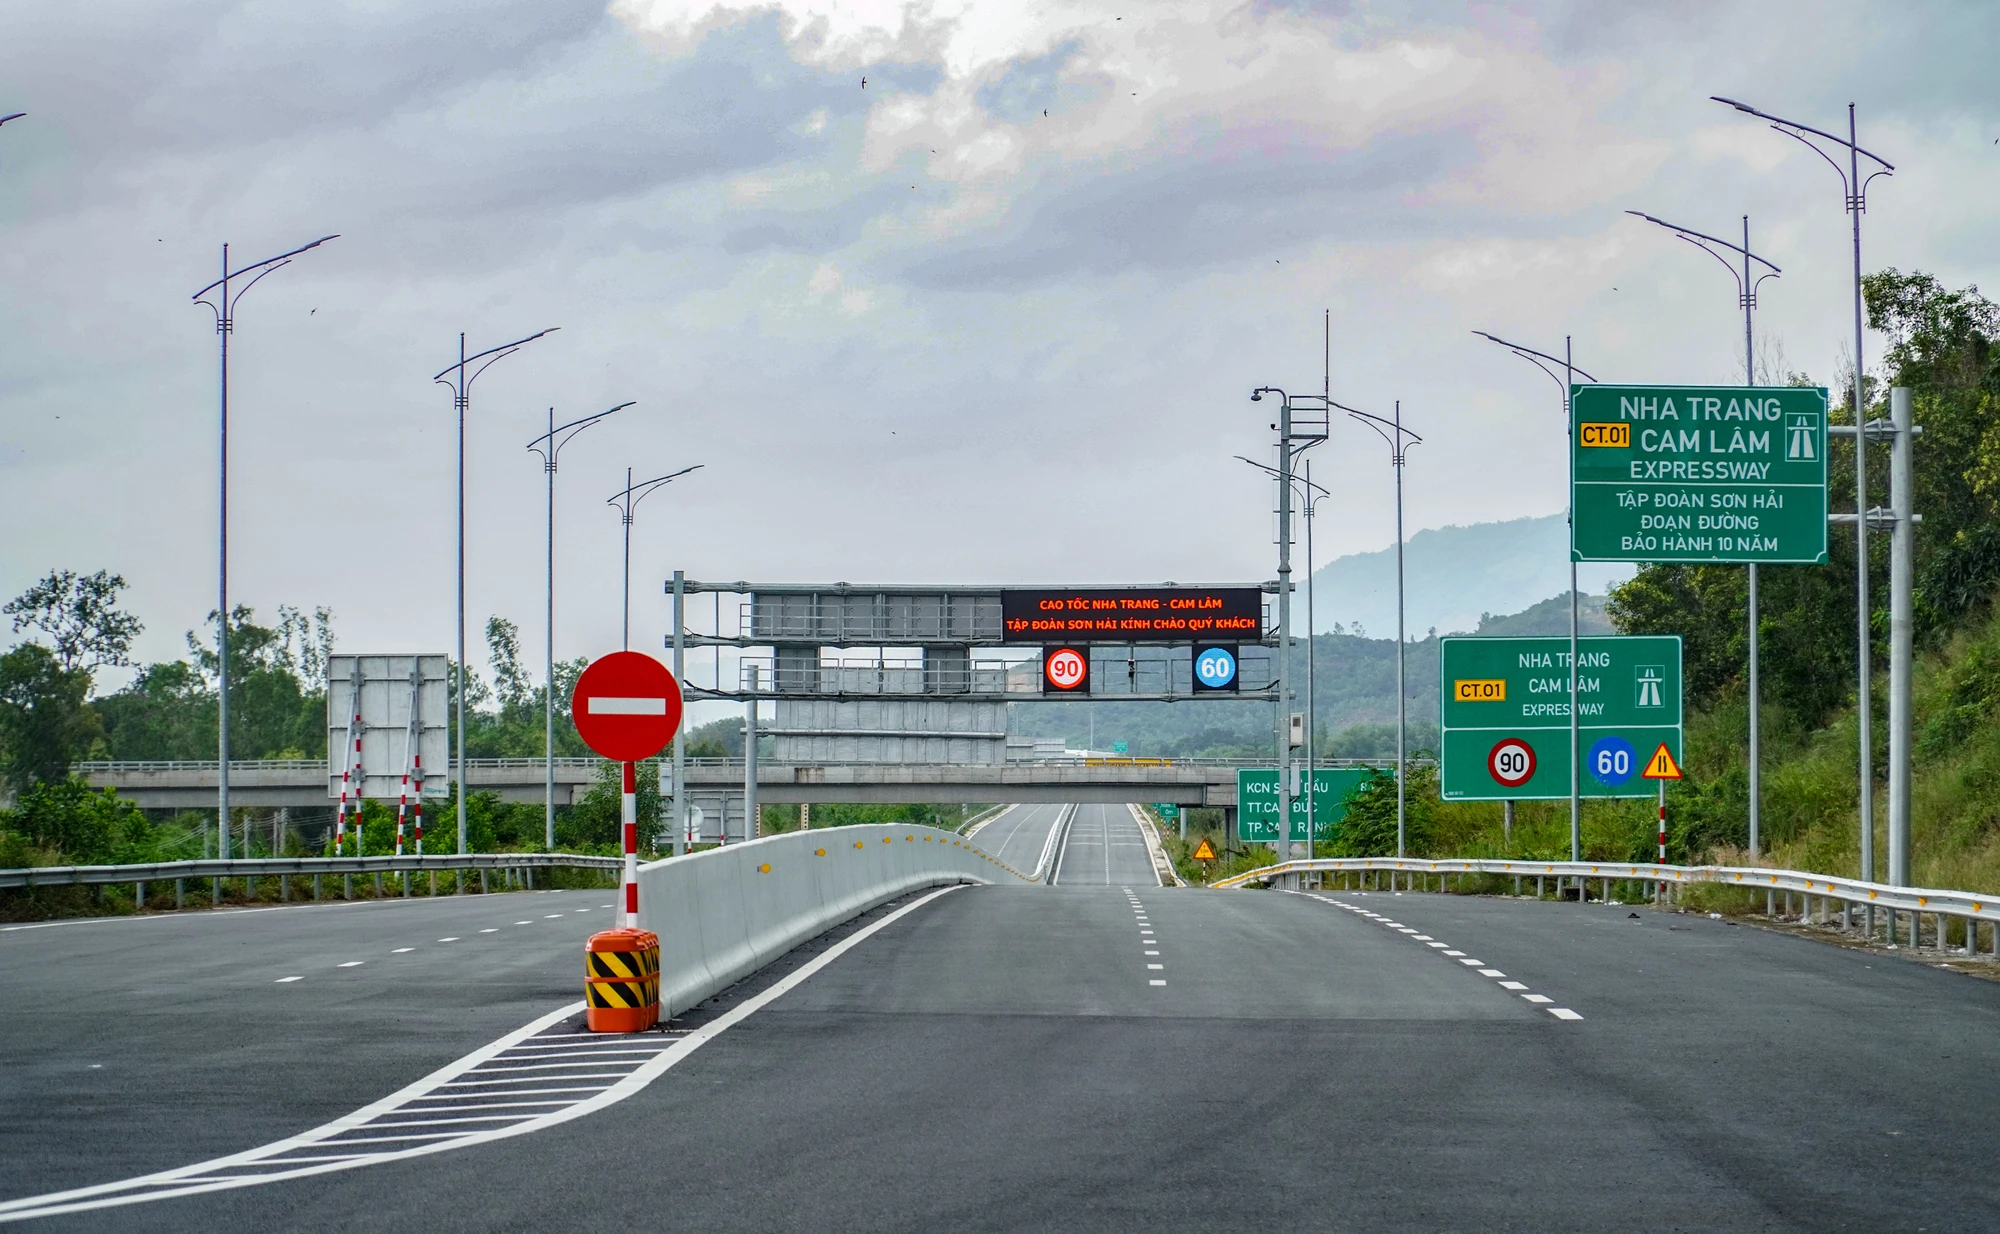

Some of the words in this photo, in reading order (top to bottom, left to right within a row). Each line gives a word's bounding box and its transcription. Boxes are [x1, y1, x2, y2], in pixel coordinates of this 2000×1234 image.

[1620, 396, 1679, 421] NHA
[1687, 397, 1782, 422] TRANG
[1582, 426, 1627, 445] CT.01
[1641, 428, 1700, 453] CAM
[1710, 426, 1770, 454] LÂM
[1630, 460, 1771, 480] EXPRESSWAY
[1616, 489, 1649, 511] TẬP
[1654, 489, 1704, 508] ĐOÀN
[1710, 492, 1747, 509] SƠN
[1753, 489, 1783, 509] HẢI
[1640, 514, 1691, 532] ĐOẠN
[1698, 511, 1759, 531] ĐƯỜNG
[1621, 531, 1657, 551] BẢO
[1662, 532, 1712, 551] HÀNH
[1717, 537, 1733, 551] 10
[1738, 534, 1778, 552] NĂM
[1039, 600, 1064, 610] CAO
[1067, 598, 1090, 610] TỐC
[1092, 599, 1117, 610] NHA
[1119, 599, 1160, 610] TRANG
[1170, 599, 1196, 609] CAM
[1198, 596, 1222, 609] LÂM
[1006, 618, 1029, 631] TẬP
[1032, 617, 1065, 630] ĐOÀN
[1067, 618, 1094, 630] SƠN
[1096, 617, 1117, 630] HẢI
[1120, 616, 1151, 629] KÍNH
[1153, 616, 1186, 629] CHÀO
[1188, 616, 1213, 631] QUÝ
[1215, 615, 1256, 629] KHÁCH
[1054, 660, 1079, 677] 90
[1201, 657, 1229, 678] 60
[1519, 653, 1553, 668] NHA
[1556, 652, 1610, 668] TRANG
[1461, 683, 1501, 698] CT.01
[1529, 678, 1561, 693] CAM
[1567, 675, 1600, 693] LÂM
[1522, 703, 1605, 716] EXPRESWAY
[1500, 752, 1525, 773] 90
[1597, 750, 1629, 775] 60
[1246, 782, 1270, 793] KCN
[1247, 802, 1280, 813] TT.CA
[1247, 822, 1263, 833] TP.
